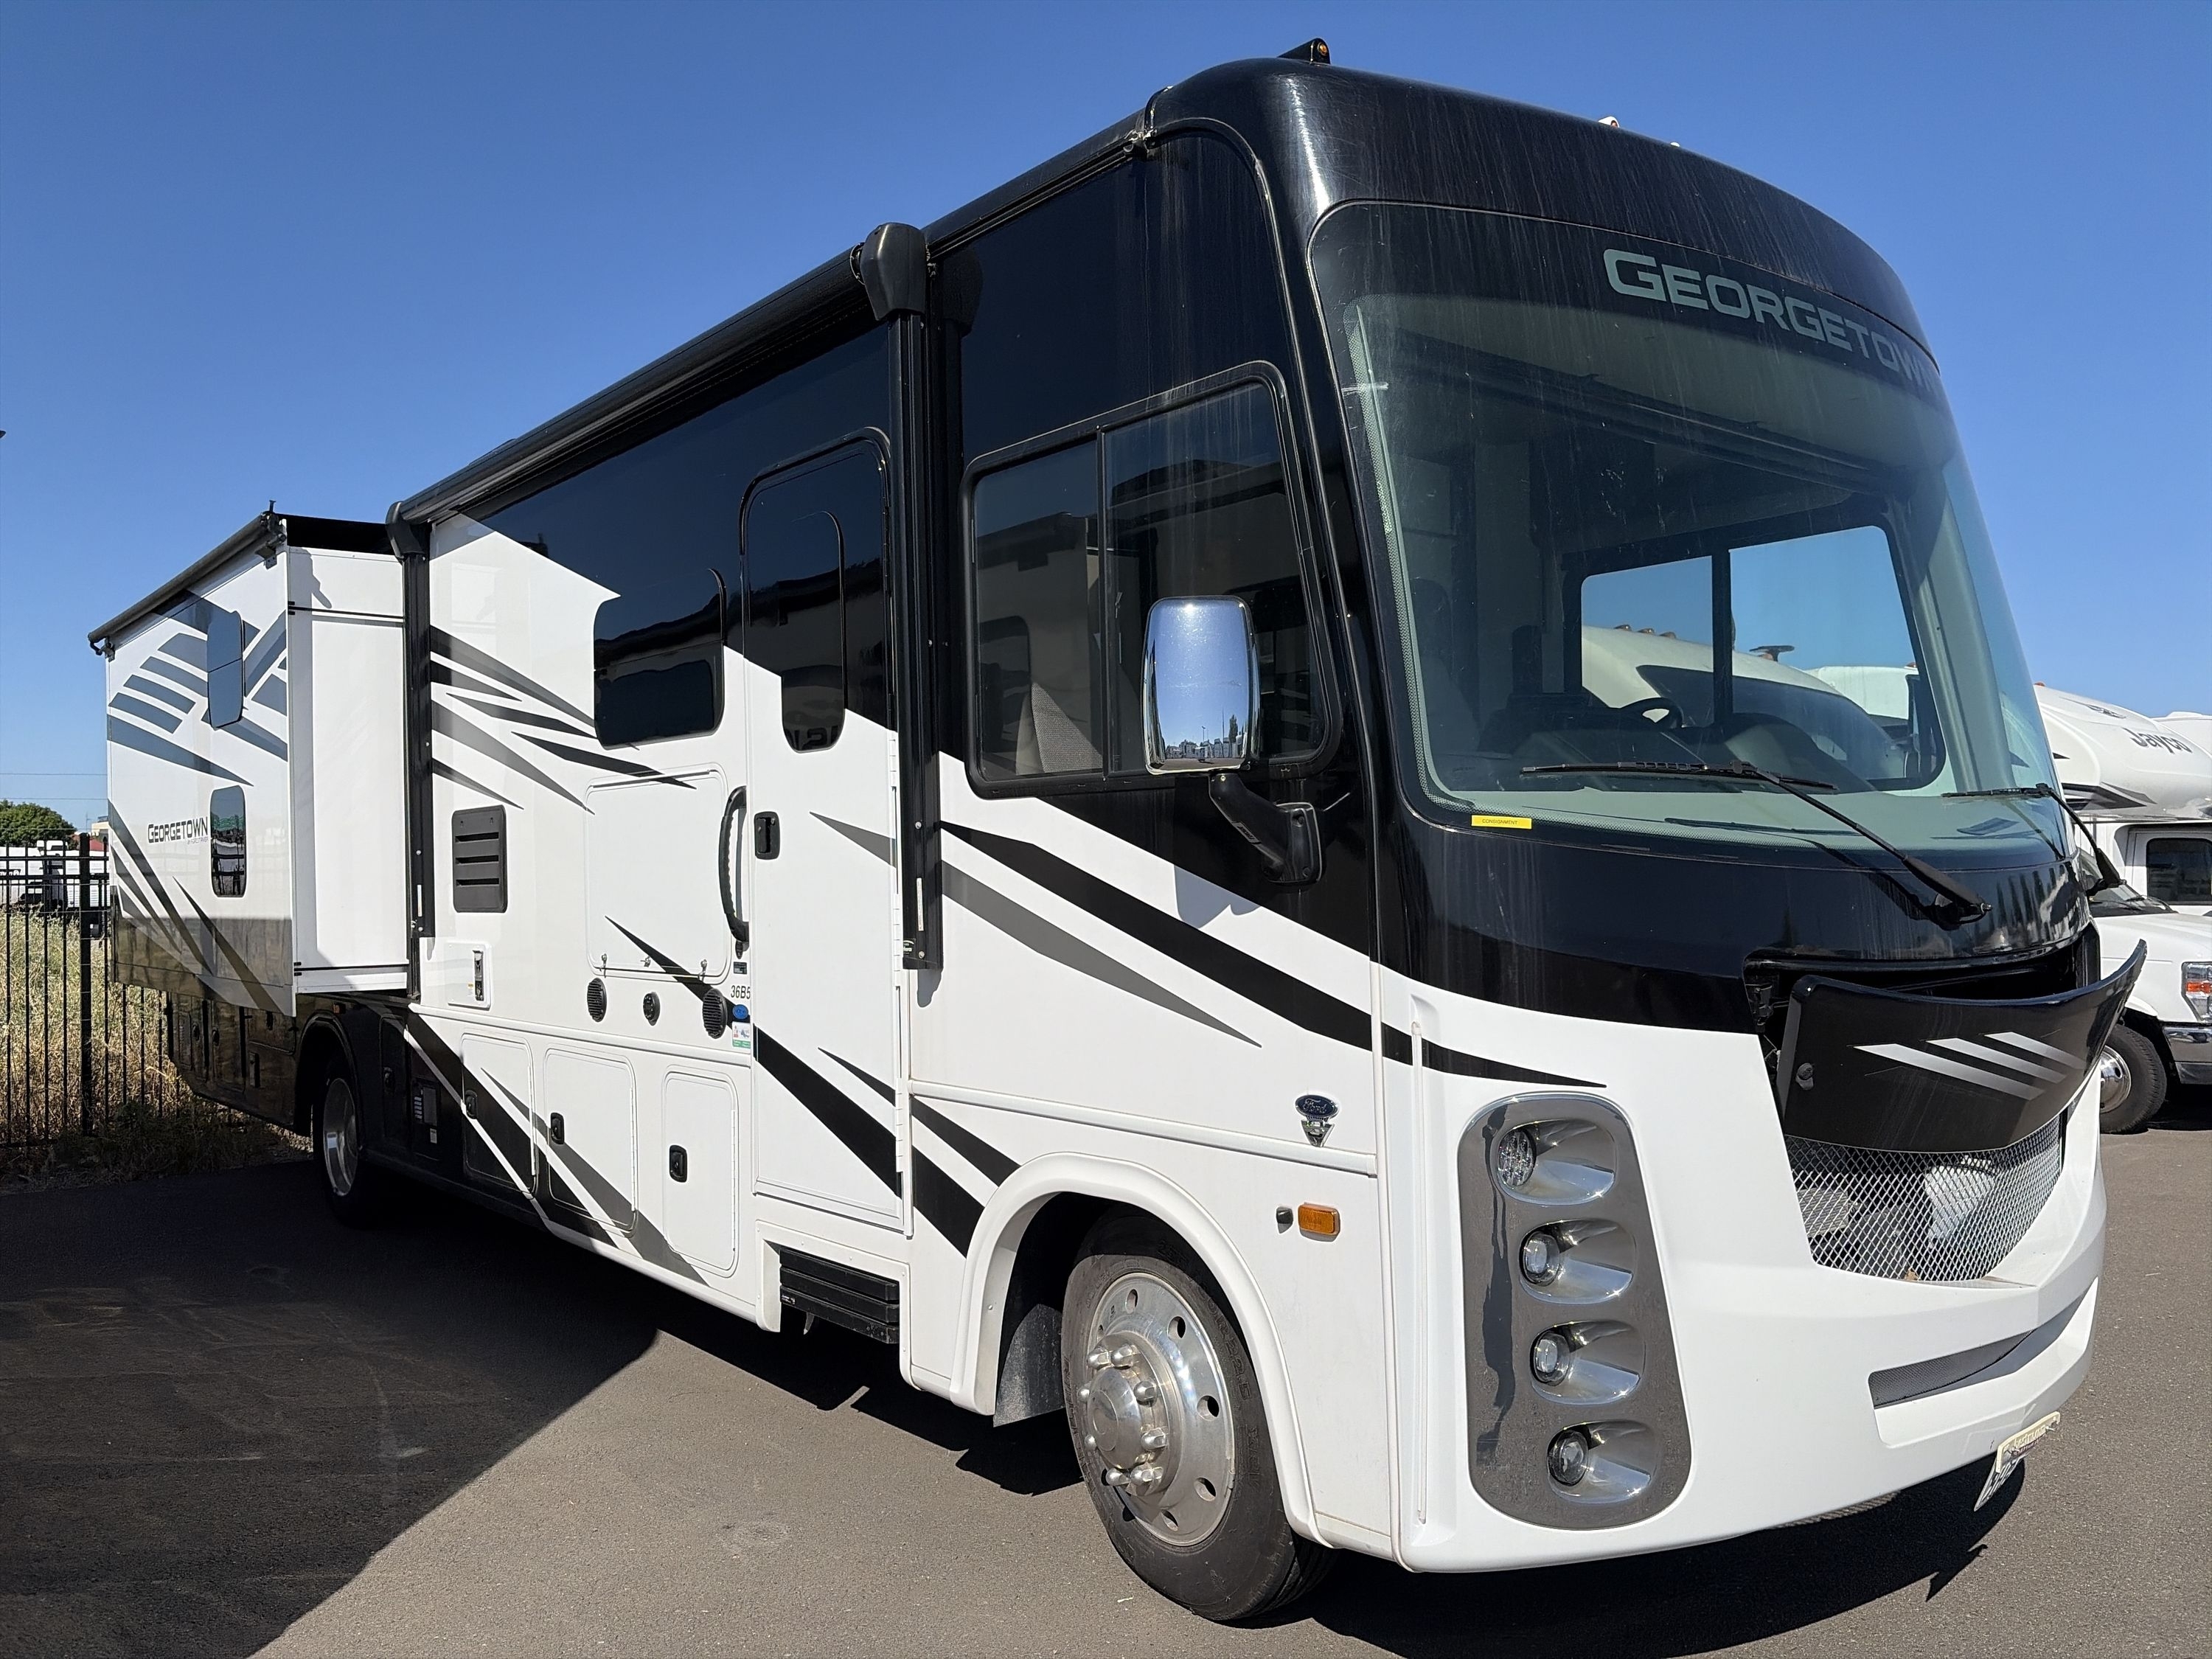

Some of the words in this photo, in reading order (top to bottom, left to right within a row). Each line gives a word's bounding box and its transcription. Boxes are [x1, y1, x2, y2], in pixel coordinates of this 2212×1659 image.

[1603, 248, 1938, 396] GEORGETOWN
[2121, 726, 2193, 754] Jayco
[148, 816, 208, 844] GEORGETOWN
[1302, 1098, 1327, 1114] Ford
